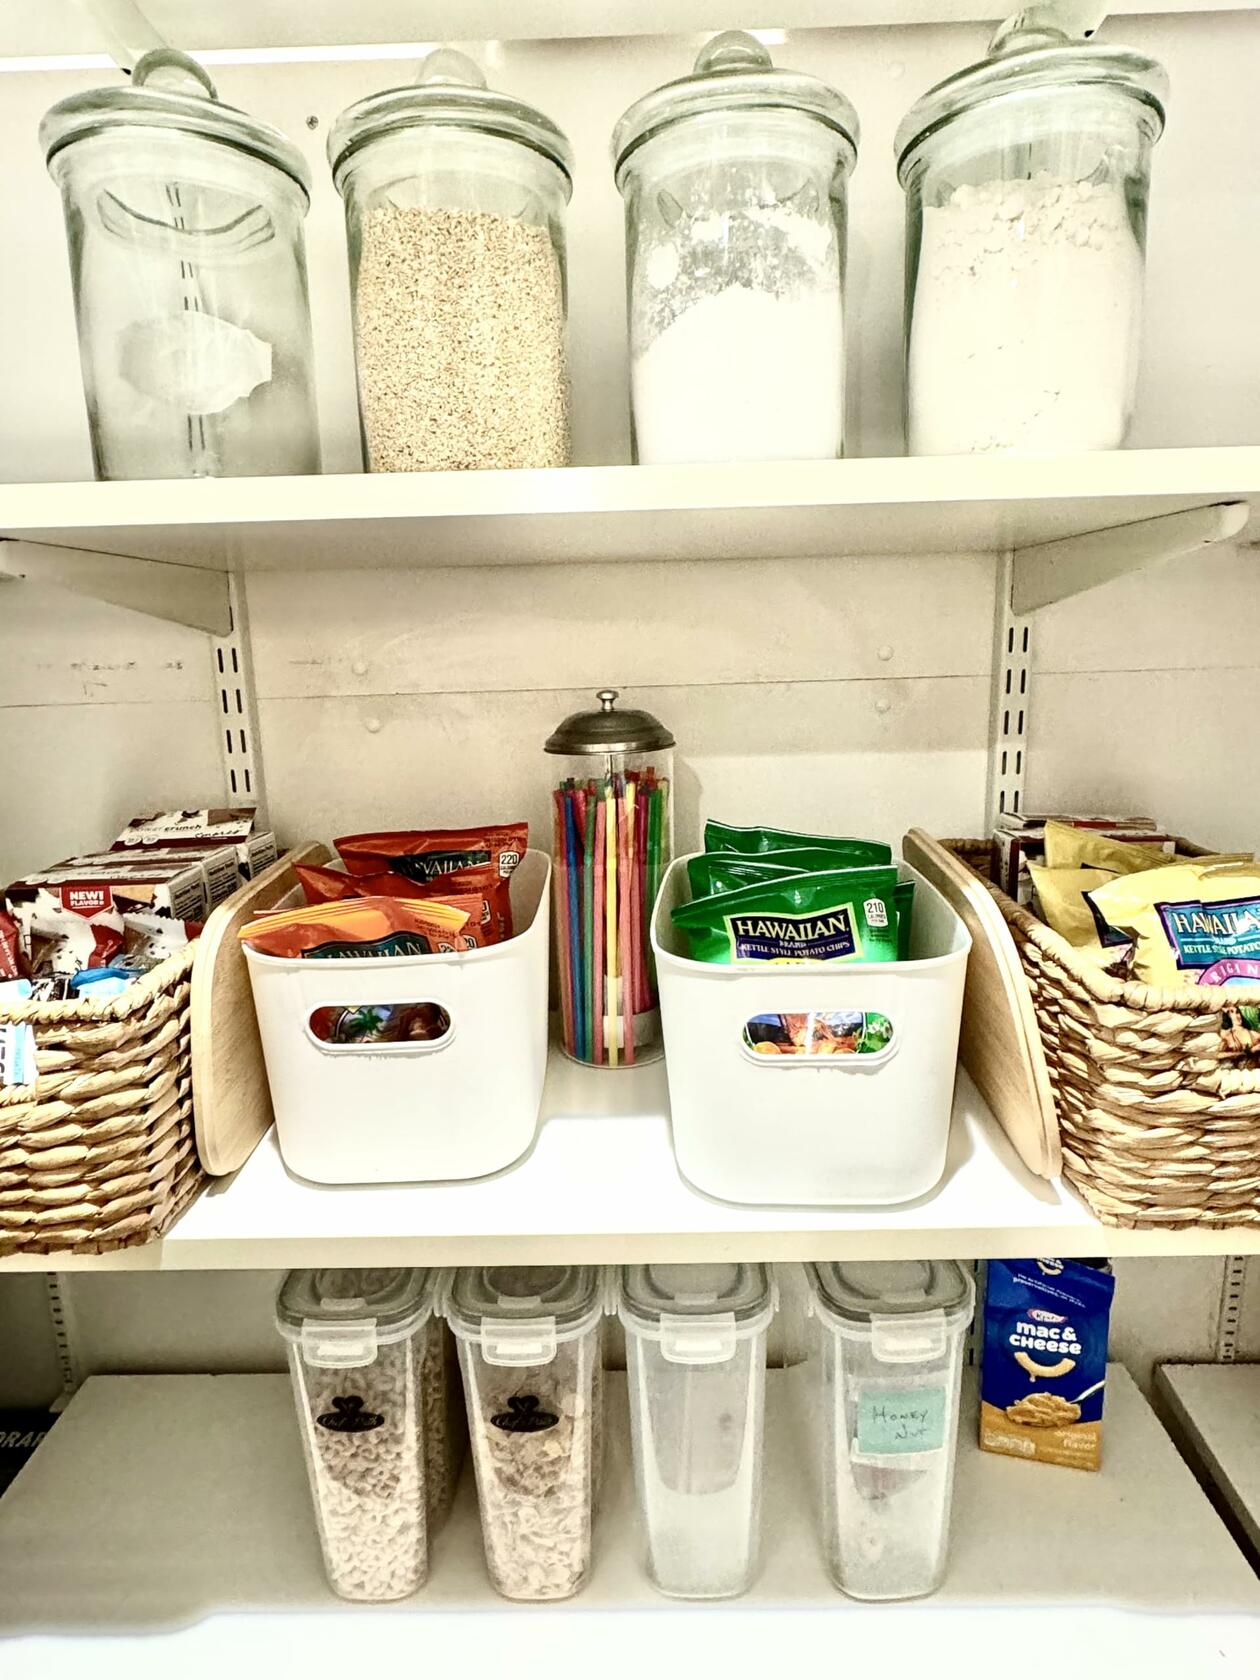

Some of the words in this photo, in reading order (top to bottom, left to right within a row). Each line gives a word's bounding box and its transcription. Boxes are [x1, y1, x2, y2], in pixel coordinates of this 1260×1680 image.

[501, 854, 518, 865] 220
[70, 891, 104, 901] NEW!
[866, 902, 884, 914] 210
[736, 914, 846, 941] HAWAIIAN
[1172, 909, 1260, 935] HAWAIIA
[1016, 1321, 1061, 1339] mac
[1062, 1327, 1077, 1341] &
